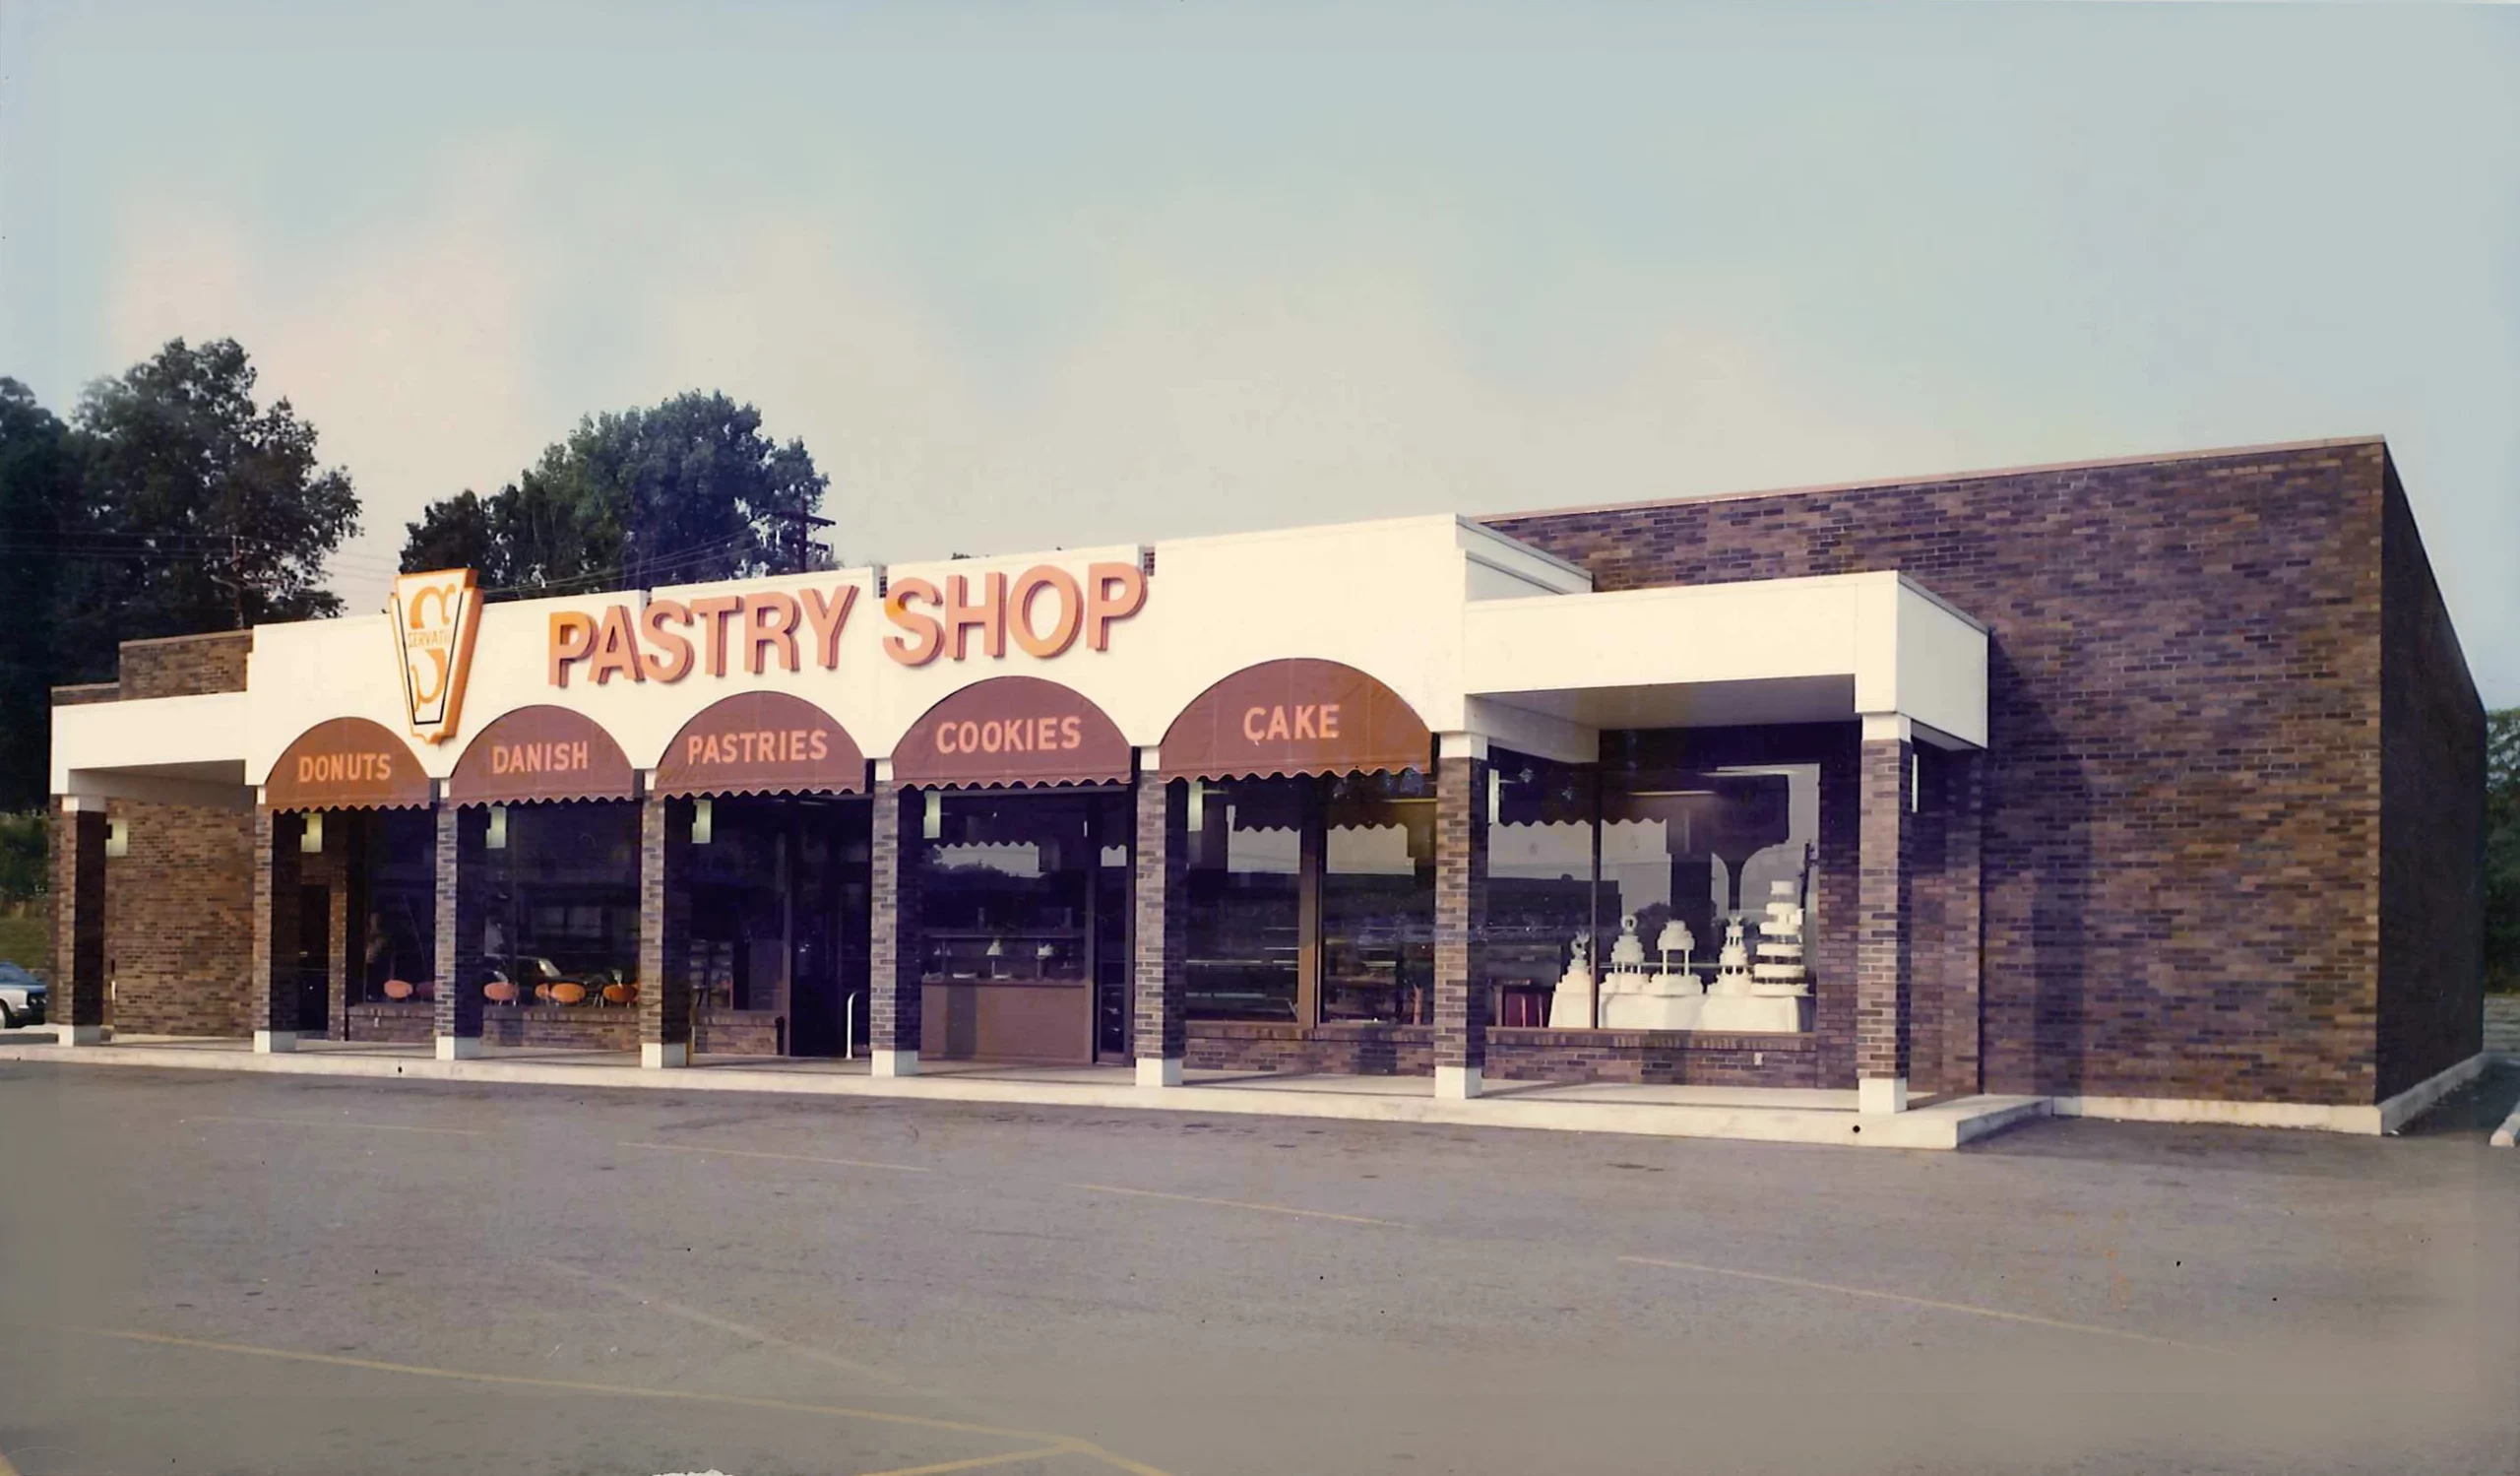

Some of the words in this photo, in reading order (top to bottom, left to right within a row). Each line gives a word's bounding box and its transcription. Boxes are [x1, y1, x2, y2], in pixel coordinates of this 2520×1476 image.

[548, 585, 860, 687] PASTRY
[883, 562, 1148, 667] SHOP
[935, 717, 1082, 754] COOKIES
[1243, 704, 1341, 741] CAKE
[492, 740, 589, 775] DANISH
[688, 730, 829, 765] PASTRIES
[298, 753, 392, 783] DONUTS
